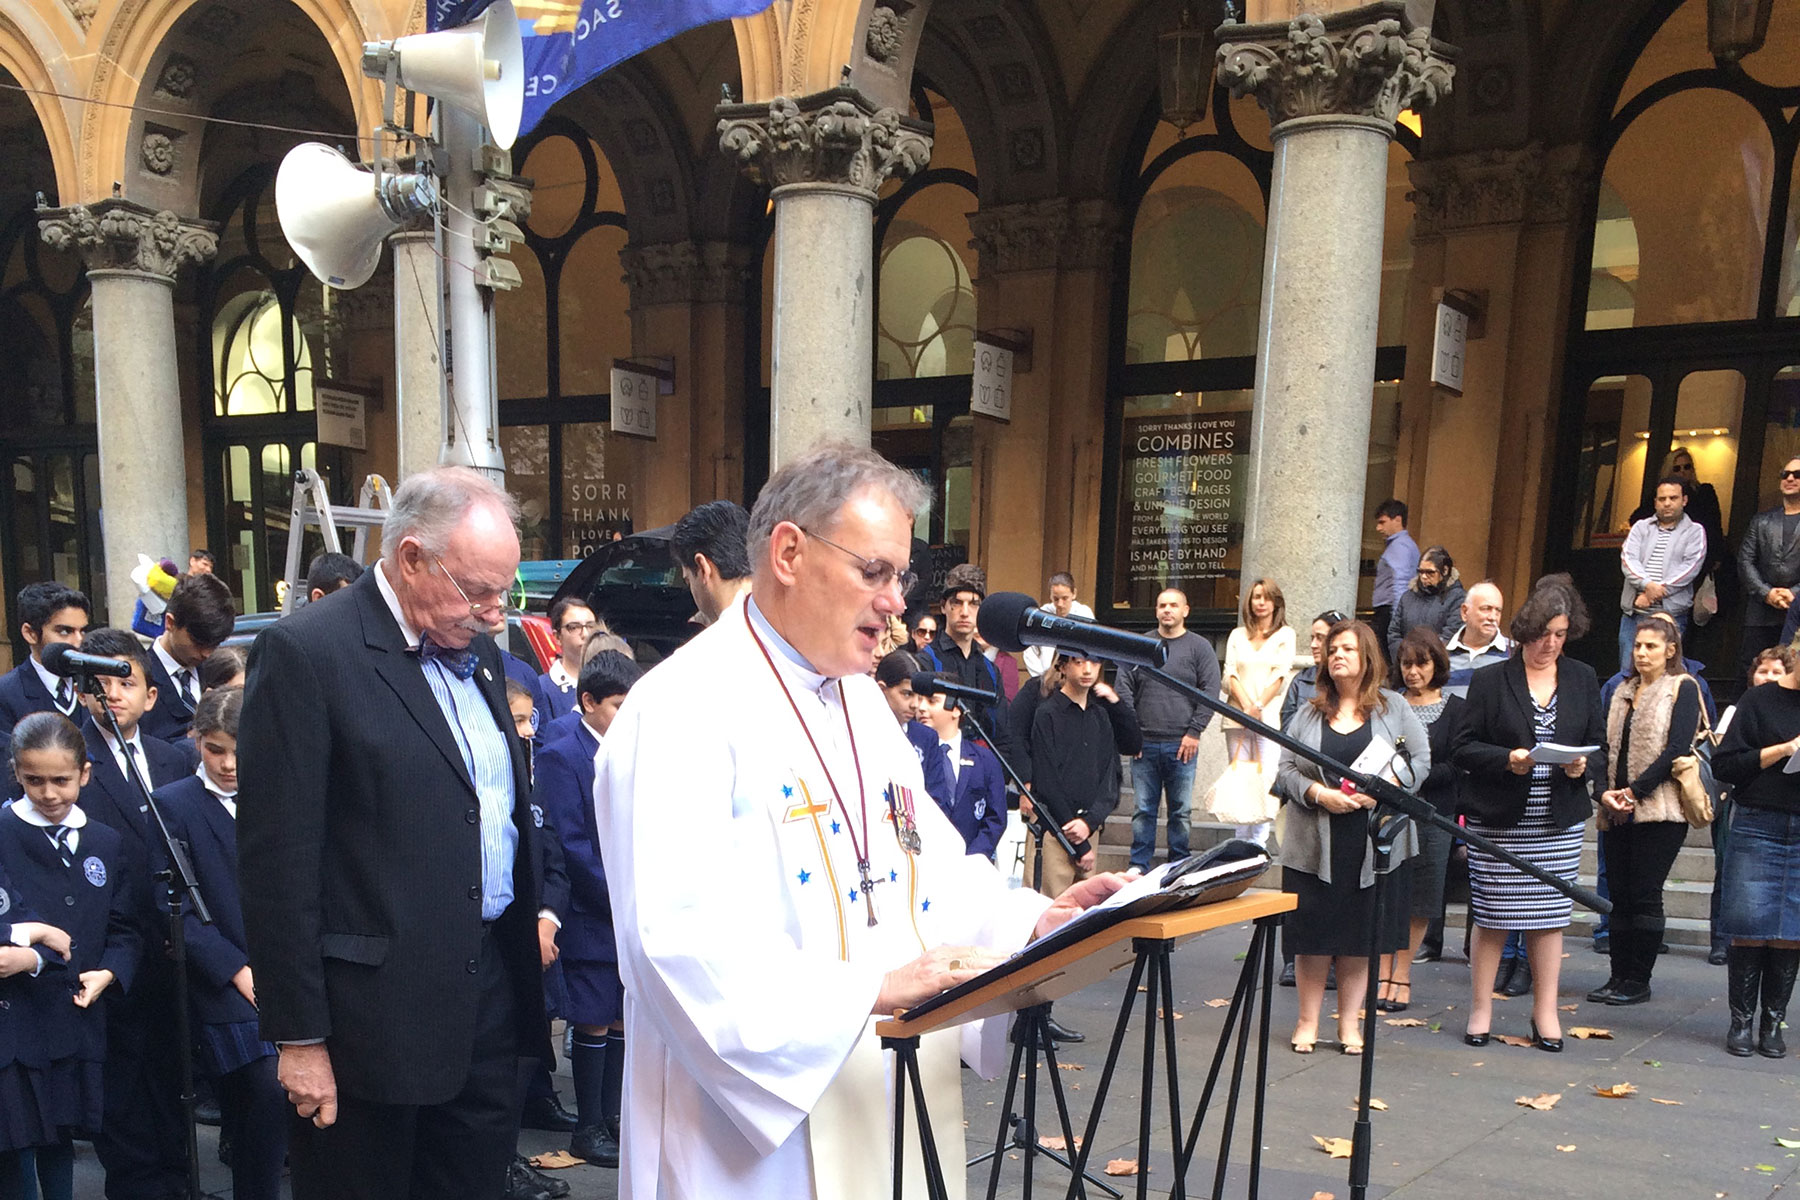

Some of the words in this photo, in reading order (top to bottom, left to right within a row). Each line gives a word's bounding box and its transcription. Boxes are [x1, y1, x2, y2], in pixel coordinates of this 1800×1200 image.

[1164, 423, 1192, 431] THANKS
[1198, 421, 1218, 430] LOVE
[1219, 420, 1236, 428] YOU
[1137, 431, 1234, 452] COMBINES
[1136, 456, 1174, 468] FRESH
[1176, 453, 1233, 467] FLOWERS
[1135, 470, 1194, 484] GOURMET
[1197, 469, 1231, 480] FOOD
[1134, 487, 1167, 498] CRAFT
[1170, 484, 1231, 496] BEVERAGES
[1133, 502, 1141, 512] &
[1189, 498, 1231, 510] DESIGN
[572, 508, 630, 521] THANK
[1132, 514, 1153, 523] FROM
[1202, 512, 1229, 521] WORLD
[581, 529, 612, 540] LOVE
[1132, 525, 1188, 535] EVERYTHING
[1190, 524, 1210, 534] YOU
[1211, 523, 1229, 533] SEE
[1131, 538, 1145, 546] HAS
[1146, 537, 1167, 546] TAKEN
[1168, 537, 1191, 545] HOURS
[1202, 536, 1228, 544] DESIGN
[572, 545, 604, 560] PO
[1131, 551, 1140, 561] IS
[1142, 550, 1175, 561] MADE
[1177, 549, 1192, 560] BY
[1193, 547, 1227, 559] HAND
[1131, 564, 1147, 572] AND
[1170, 562, 1195, 571] STORY
[1196, 562, 1207, 570] TO
[1208, 561, 1226, 570] TELL
